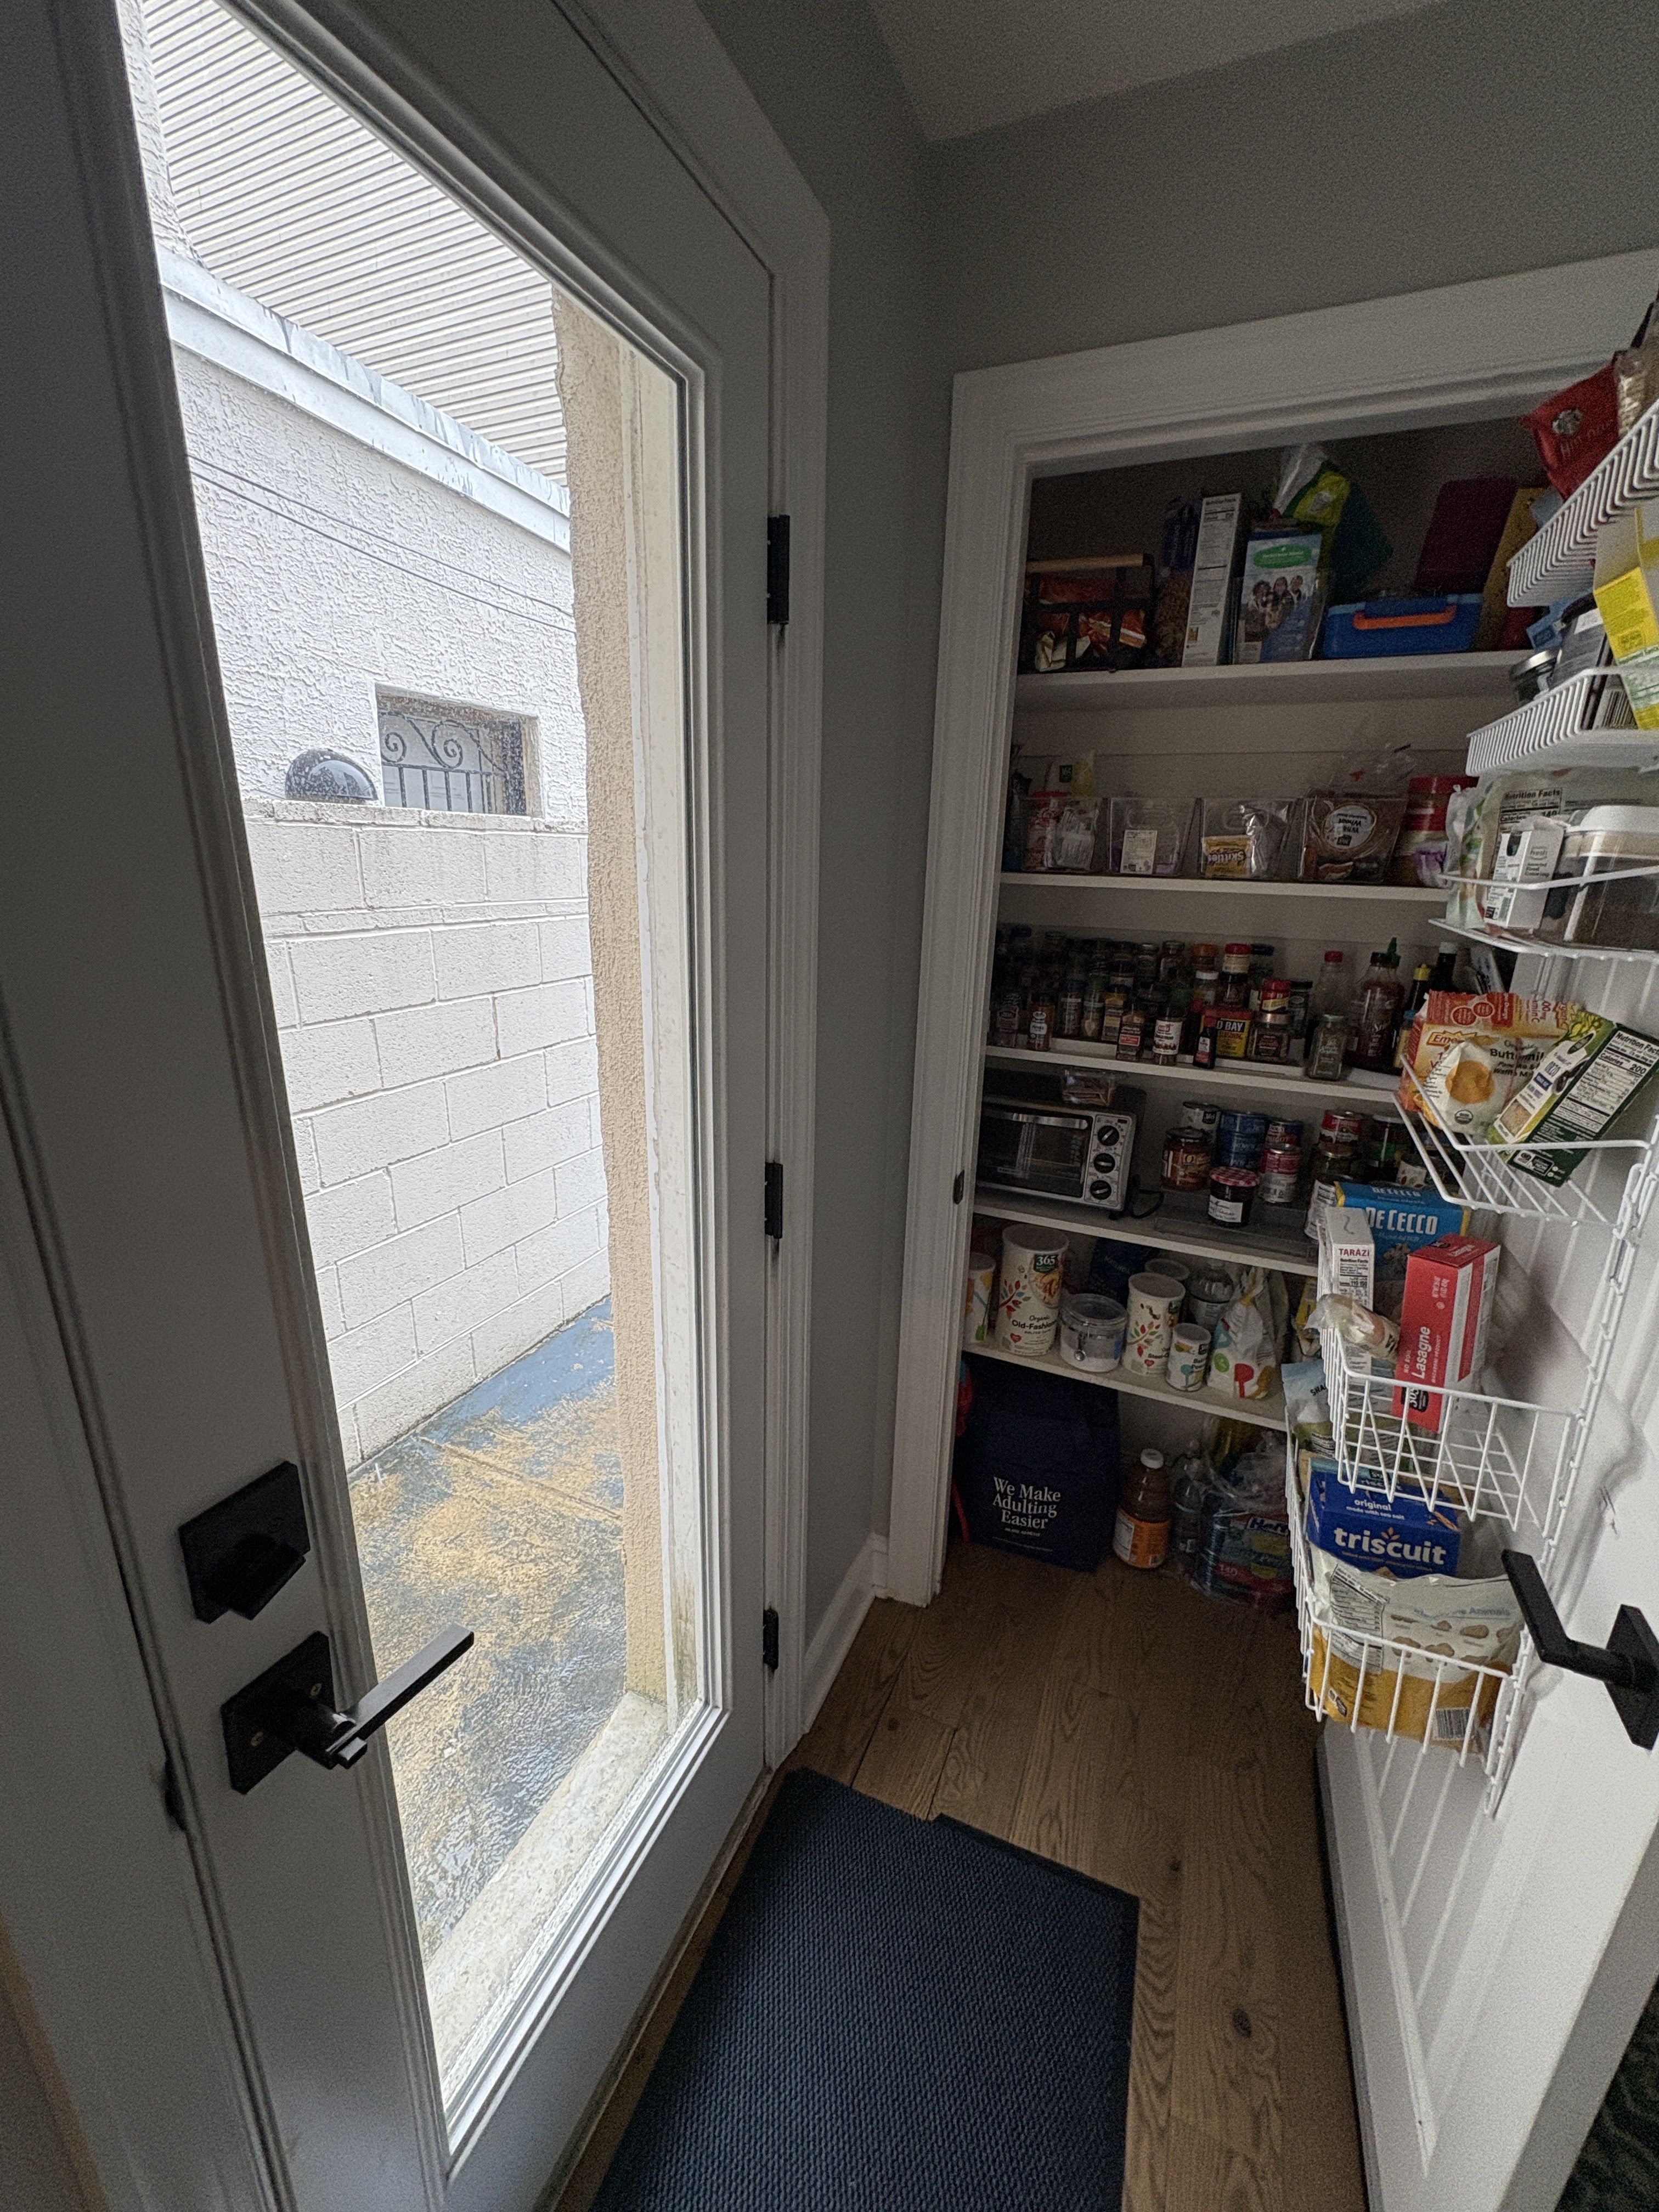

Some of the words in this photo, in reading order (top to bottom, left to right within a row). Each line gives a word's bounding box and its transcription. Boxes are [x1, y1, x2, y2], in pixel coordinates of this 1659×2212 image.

[1224, 1021, 1244, 1032] BAY
[1615, 1032, 1645, 1049] Nutrition
[1600, 1053, 1624, 1066] Calories
[1629, 1064, 1647, 1075] 200
[1365, 1206, 1386, 1230] DE
[1386, 1209, 1438, 1235] CECCO
[1035, 1255, 1057, 1266] 365
[1411, 1326, 1431, 1380] Lasagne
[992, 1476, 1015, 1496] We
[1018, 1483, 1062, 1502] Make
[991, 1492, 1058, 1519] Adulting
[1353, 1499, 1393, 1511] original
[1364, 1508, 1380, 1516] with
[1001, 1509, 1048, 1530] Easier
[1334, 1527, 1447, 1565] triscuit
